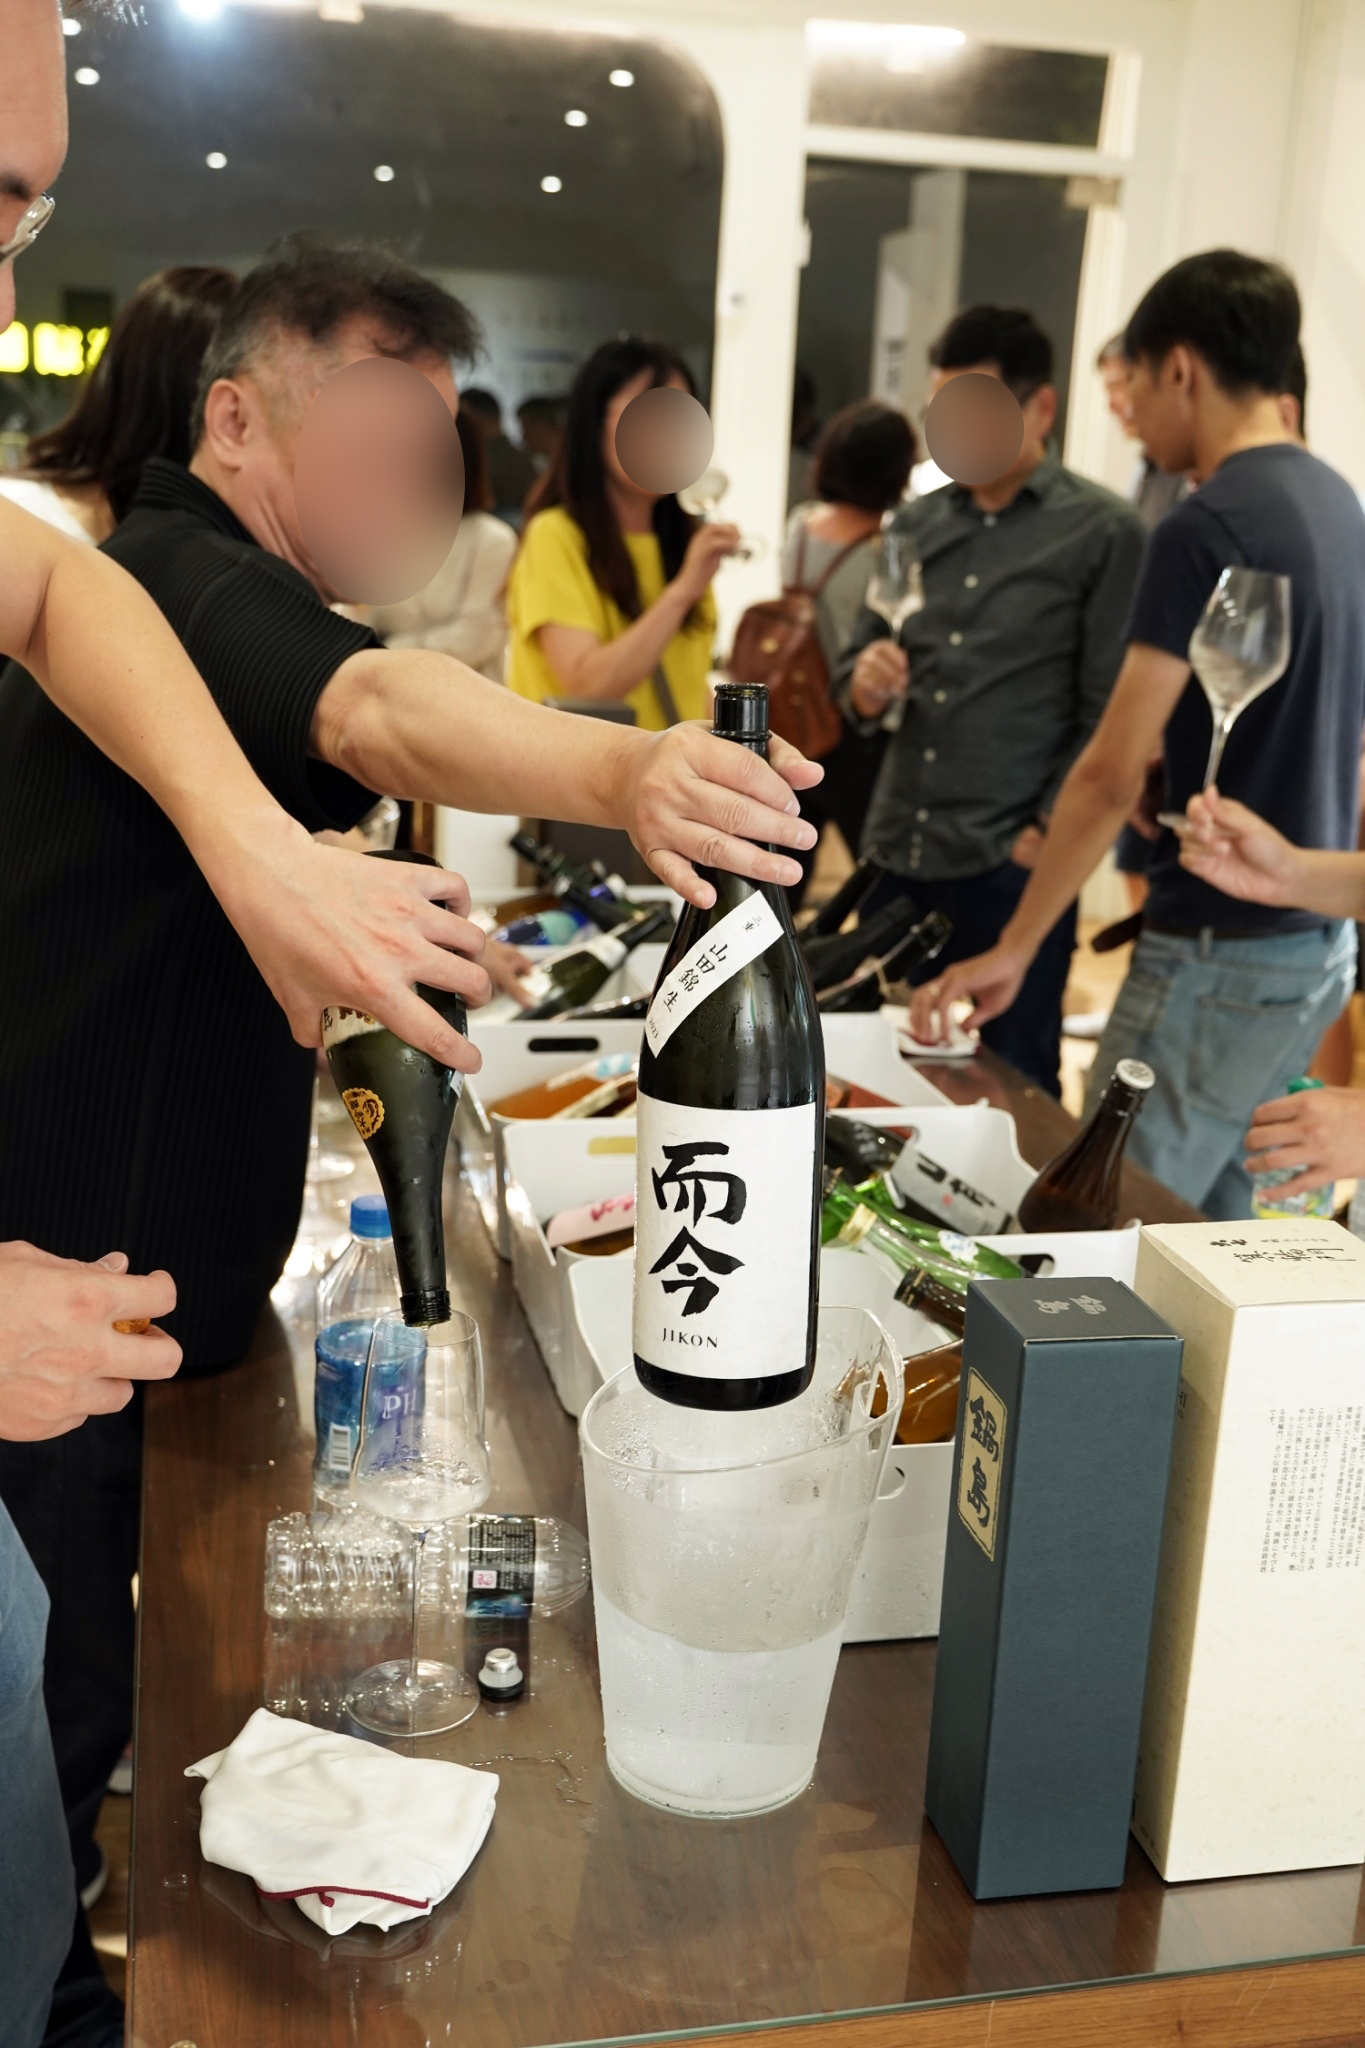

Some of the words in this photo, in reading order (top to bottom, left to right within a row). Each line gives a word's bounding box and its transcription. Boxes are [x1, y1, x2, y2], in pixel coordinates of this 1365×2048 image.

[648, 1141, 747, 1317] 而今
[661, 1327, 719, 1349] JIKON
[966, 1395, 999, 1529] 鍋島
